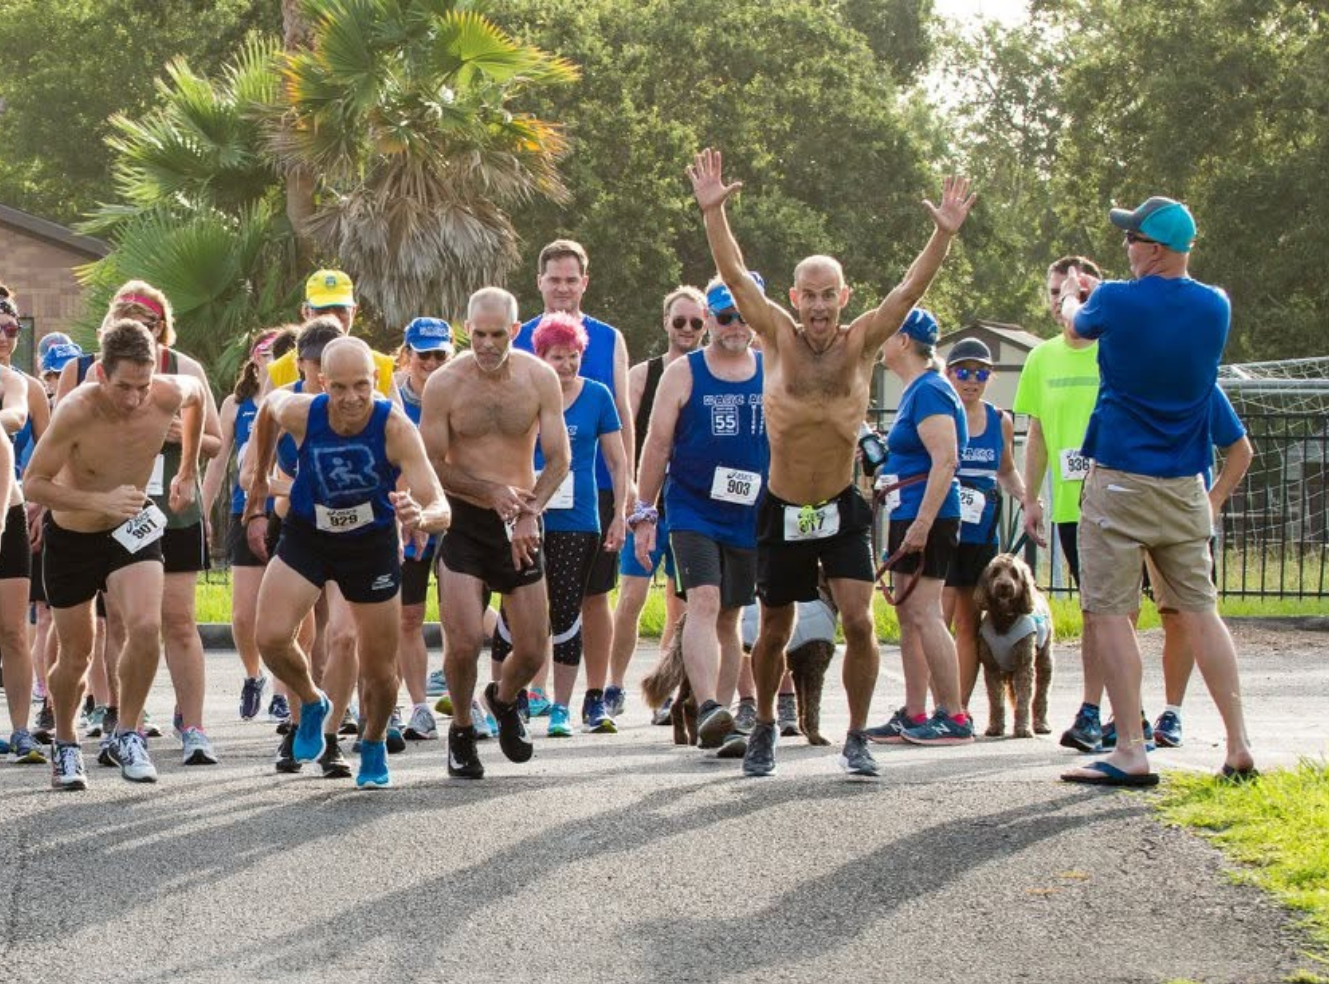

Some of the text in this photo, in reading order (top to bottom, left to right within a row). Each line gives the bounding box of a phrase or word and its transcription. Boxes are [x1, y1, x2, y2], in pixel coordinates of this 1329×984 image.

[715, 415, 736, 430] 55
[1068, 457, 1090, 472] 936
[727, 479, 751, 496] 903
[132, 518, 158, 539] 901
